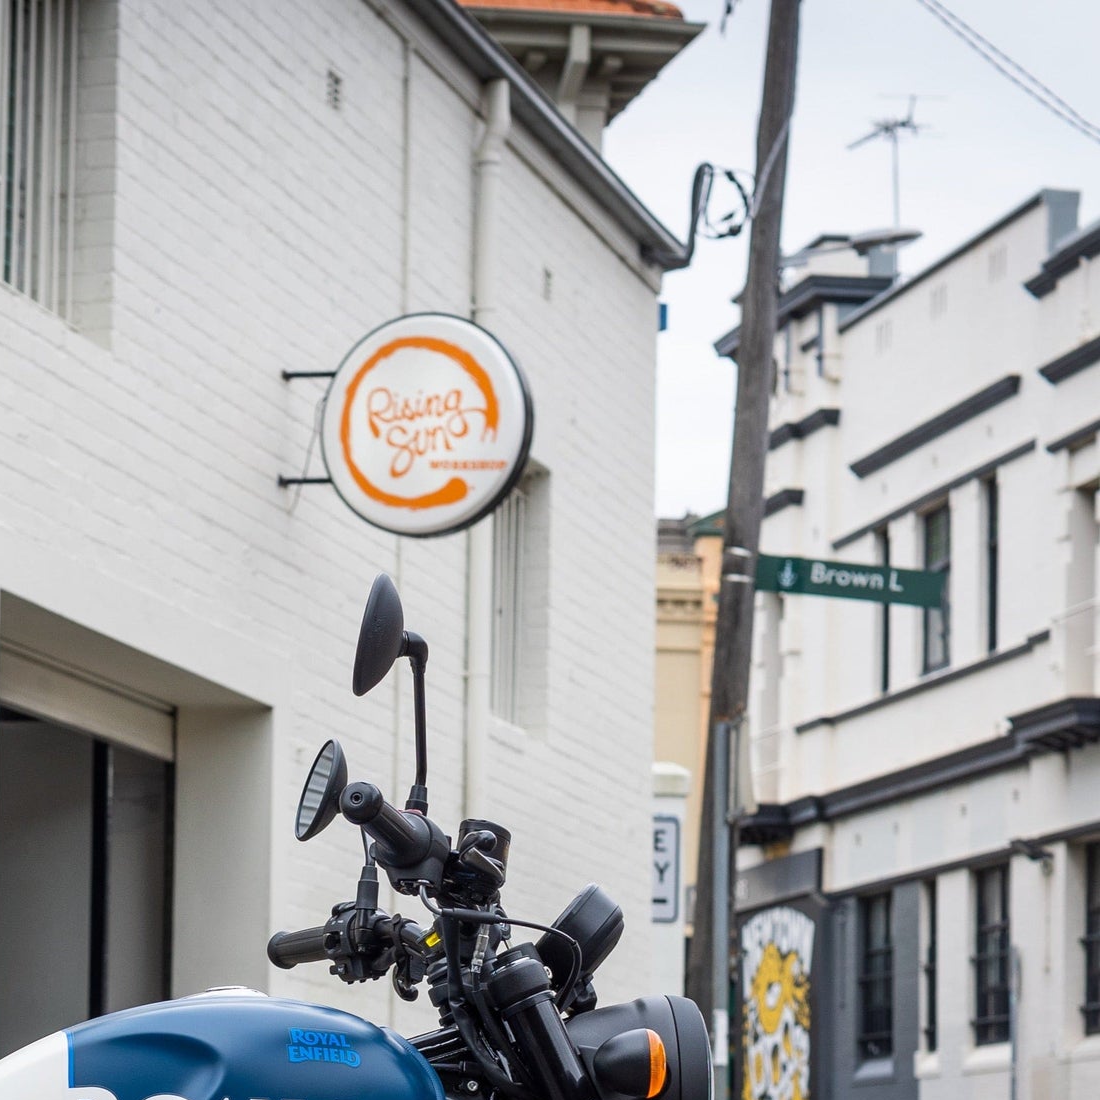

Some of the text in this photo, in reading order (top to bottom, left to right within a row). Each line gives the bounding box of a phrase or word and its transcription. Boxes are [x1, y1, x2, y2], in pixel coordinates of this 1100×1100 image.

[367, 387, 469, 438] Rising
[386, 425, 453, 478] Sun
[810, 562, 885, 591] Brown
[290, 1027, 351, 1048] ROYAL
[288, 1046, 361, 1068] ENFIELD
